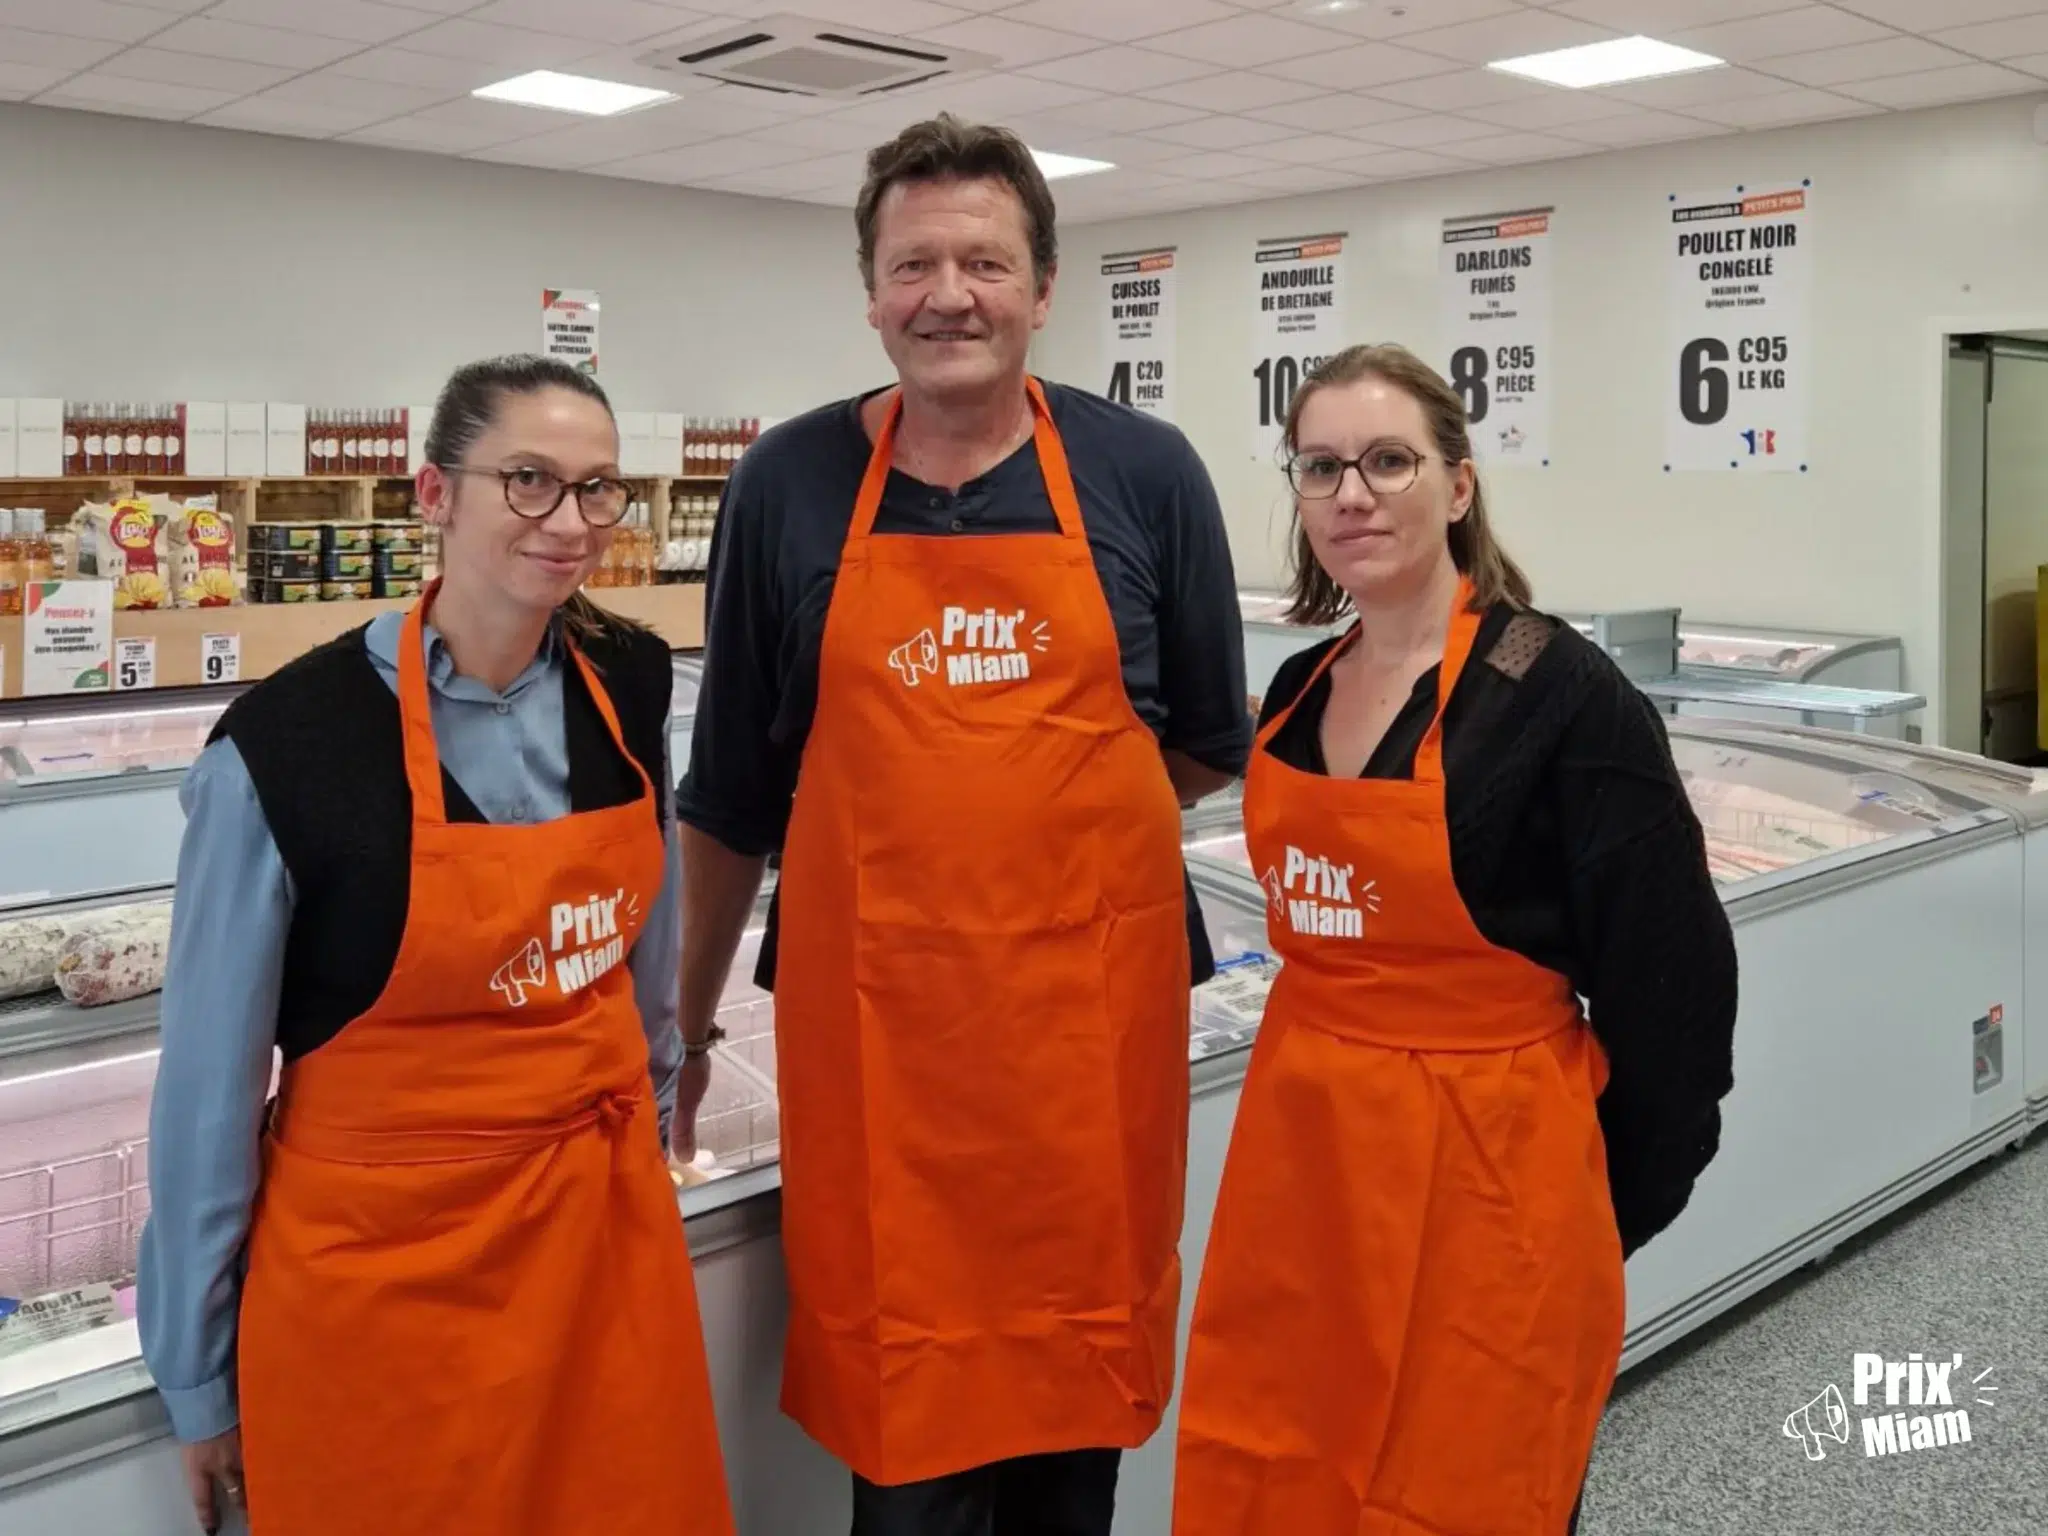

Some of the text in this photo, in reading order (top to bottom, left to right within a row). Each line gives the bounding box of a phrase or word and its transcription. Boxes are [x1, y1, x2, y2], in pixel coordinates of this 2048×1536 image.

[1678, 223, 1796, 256] POULET NOIR
[1455, 245, 1532, 273] DARLONS
[1699, 252, 1773, 281] CONGELÉ
[1111, 279, 1161, 300] CUISSES
[1261, 265, 1334, 290] ANDOUILLE
[1471, 272, 1516, 295] FUMÉS
[1112, 302, 1159, 319] DE POULET
[1262, 290, 1333, 312] DE BRETAGNE
[1136, 383, 1164, 400] PIÈCE
[1253, 355, 1298, 427] 10
[1450, 346, 1488, 424] 8
[1495, 372, 1536, 393] PIÈCE
[1679, 337, 1729, 425] 6
[1738, 368, 1786, 390] LE KG
[942, 605, 1025, 649] Prix'
[120, 661, 137, 687] 5
[206, 655, 223, 680] 9
[946, 651, 1031, 686] Miam
[1283, 844, 1355, 904] Prix'
[551, 887, 625, 952] Prix'
[1287, 898, 1364, 938] Miam
[555, 934, 624, 995] Miam
